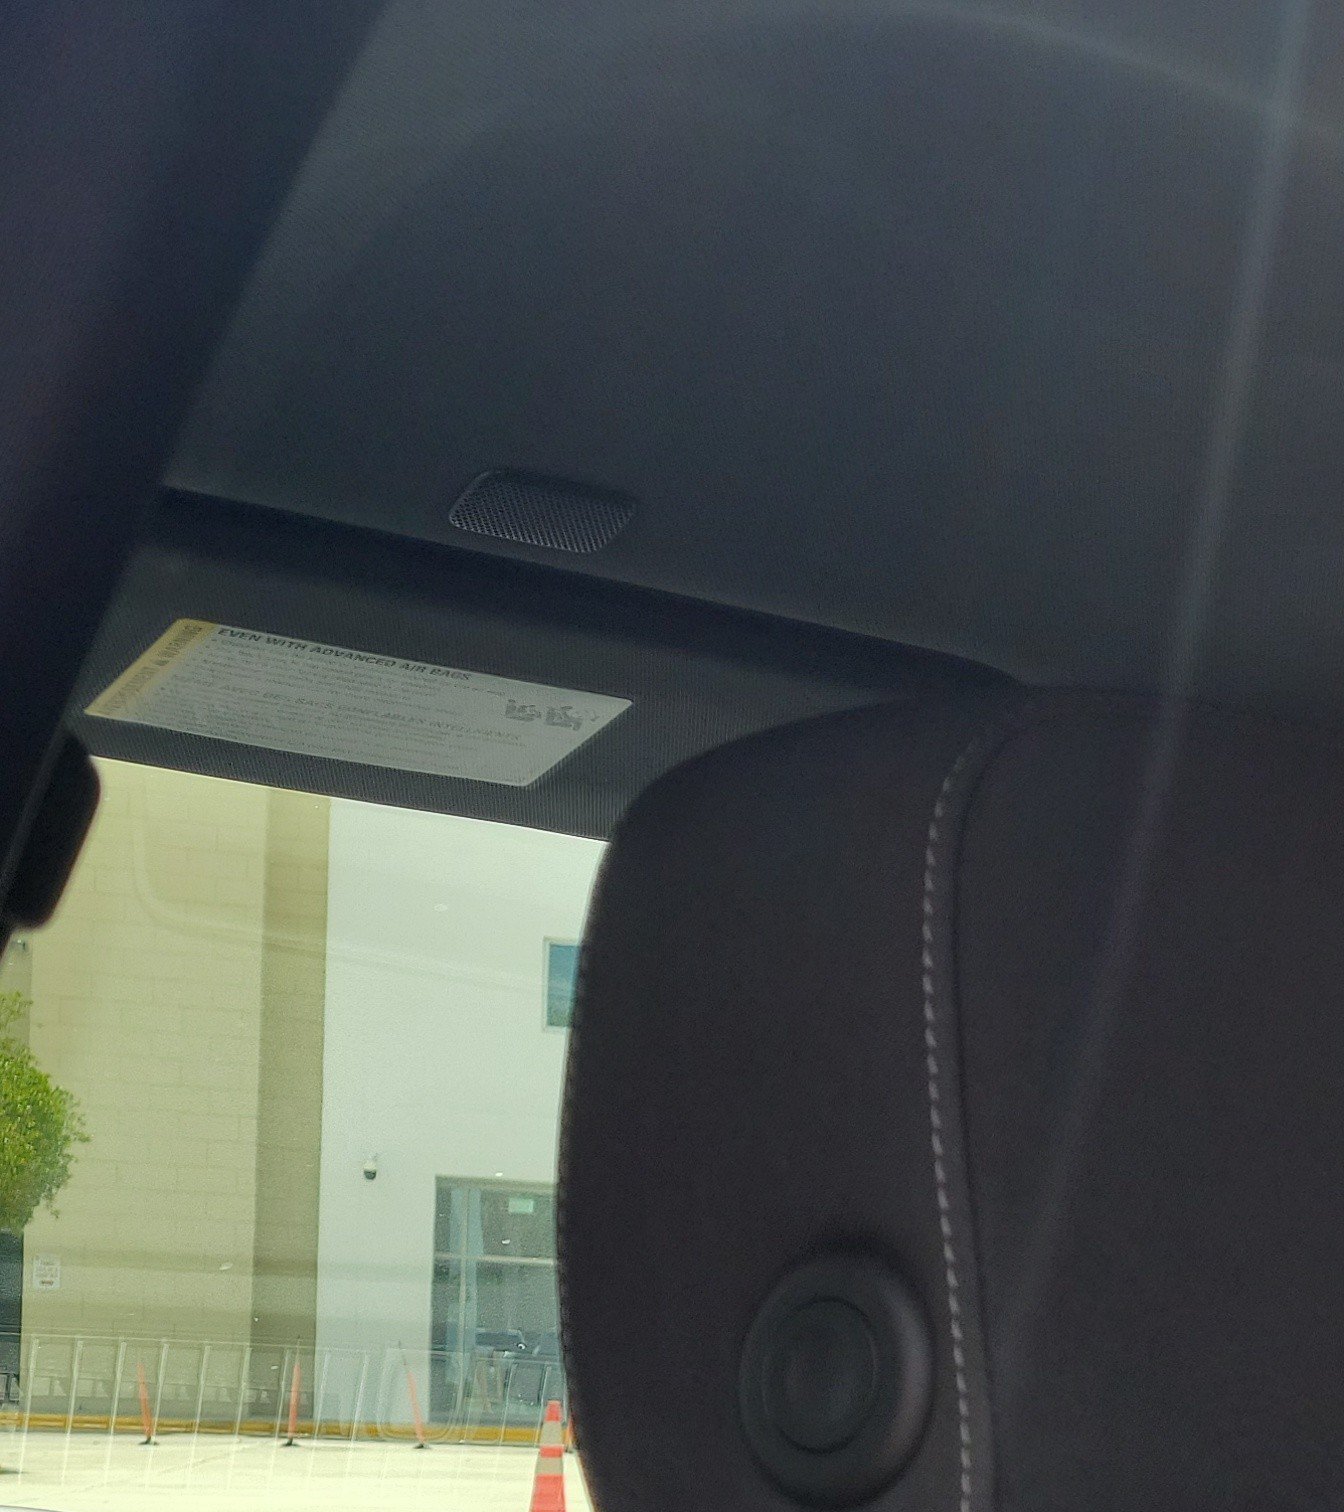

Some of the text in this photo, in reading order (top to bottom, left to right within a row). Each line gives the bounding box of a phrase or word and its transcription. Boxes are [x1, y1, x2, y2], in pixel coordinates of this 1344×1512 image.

[217, 627, 262, 642] EVEN
[265, 635, 308, 651] WITH
[309, 645, 397, 668] ADVANCED
[398, 661, 427, 674] AIR
[429, 667, 473, 681] BAGS
